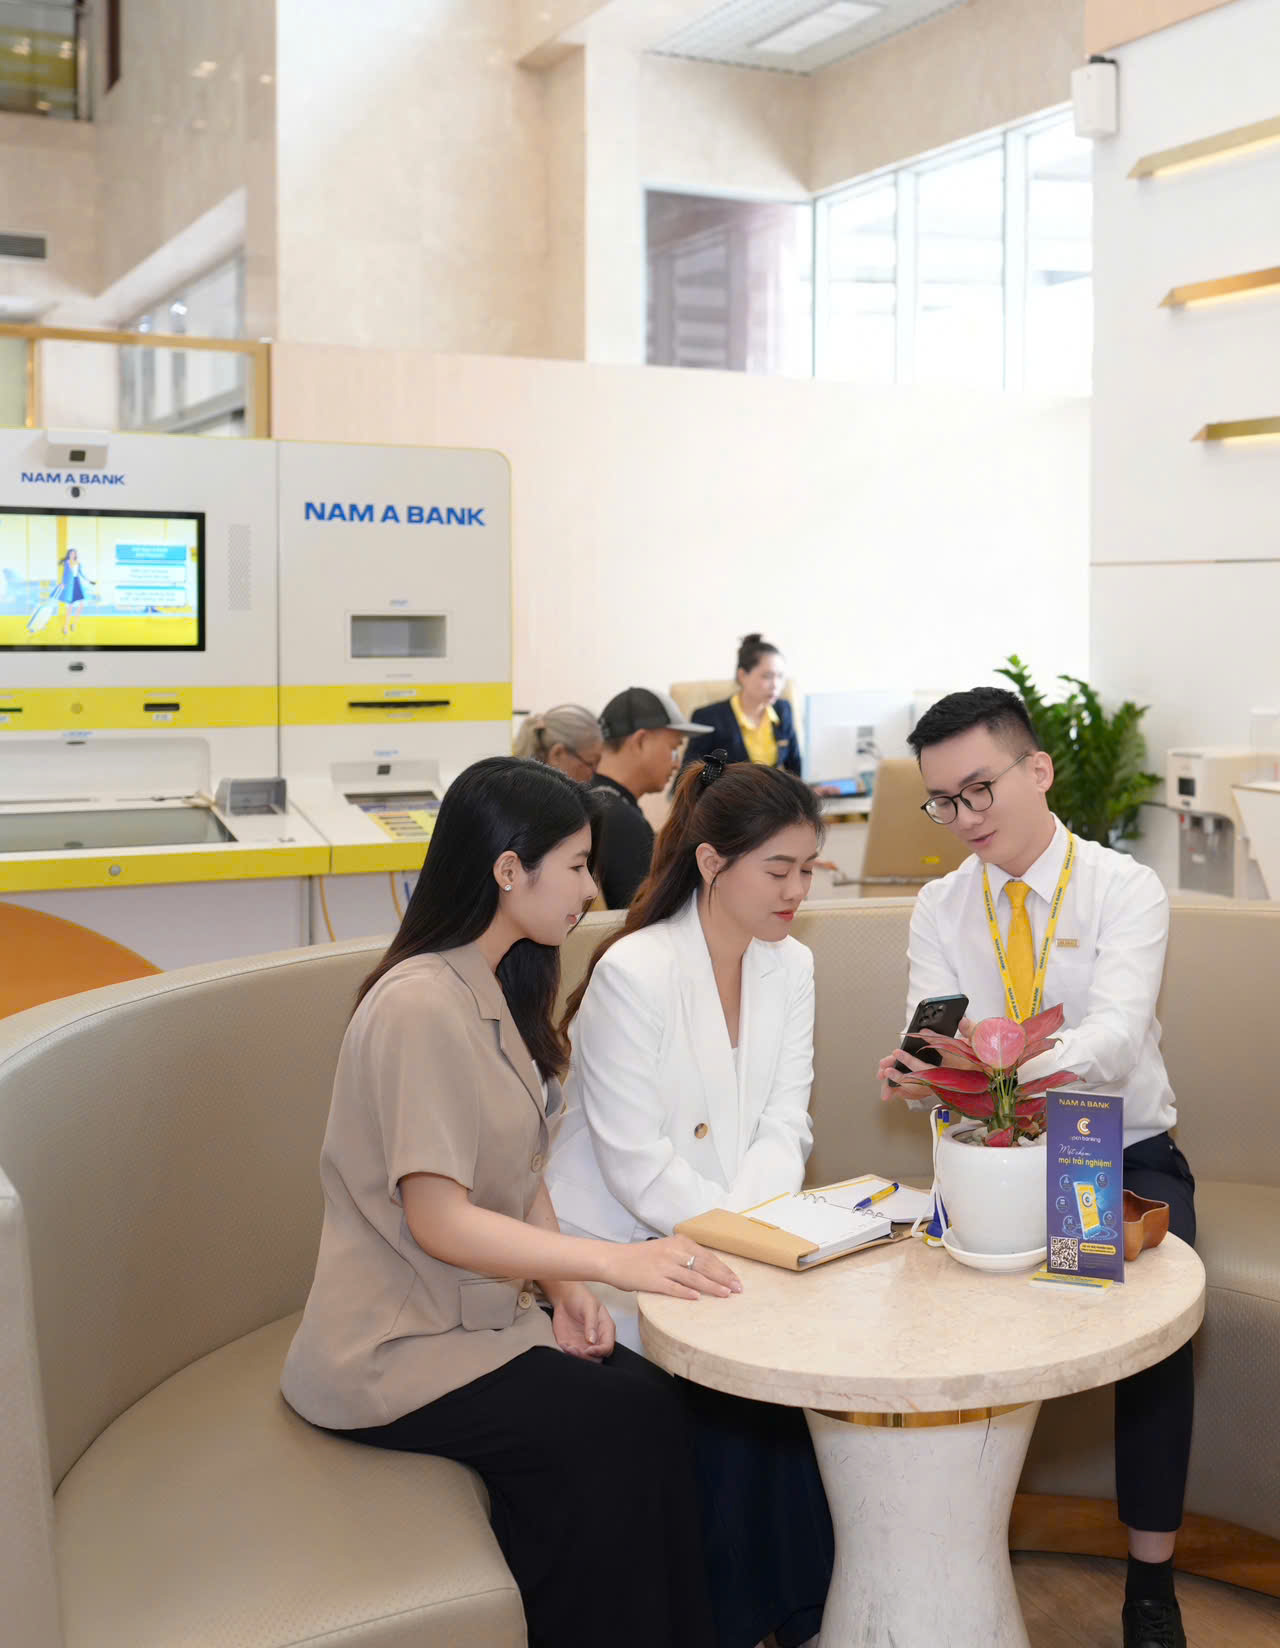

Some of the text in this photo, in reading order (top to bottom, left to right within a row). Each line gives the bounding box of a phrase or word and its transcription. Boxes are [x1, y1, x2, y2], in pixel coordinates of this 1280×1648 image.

[21, 472, 125, 485] NAM A BANK
[304, 502, 486, 526] NAM A BANK
[1058, 1156, 1112, 1168] mọi trải nghiệm!
